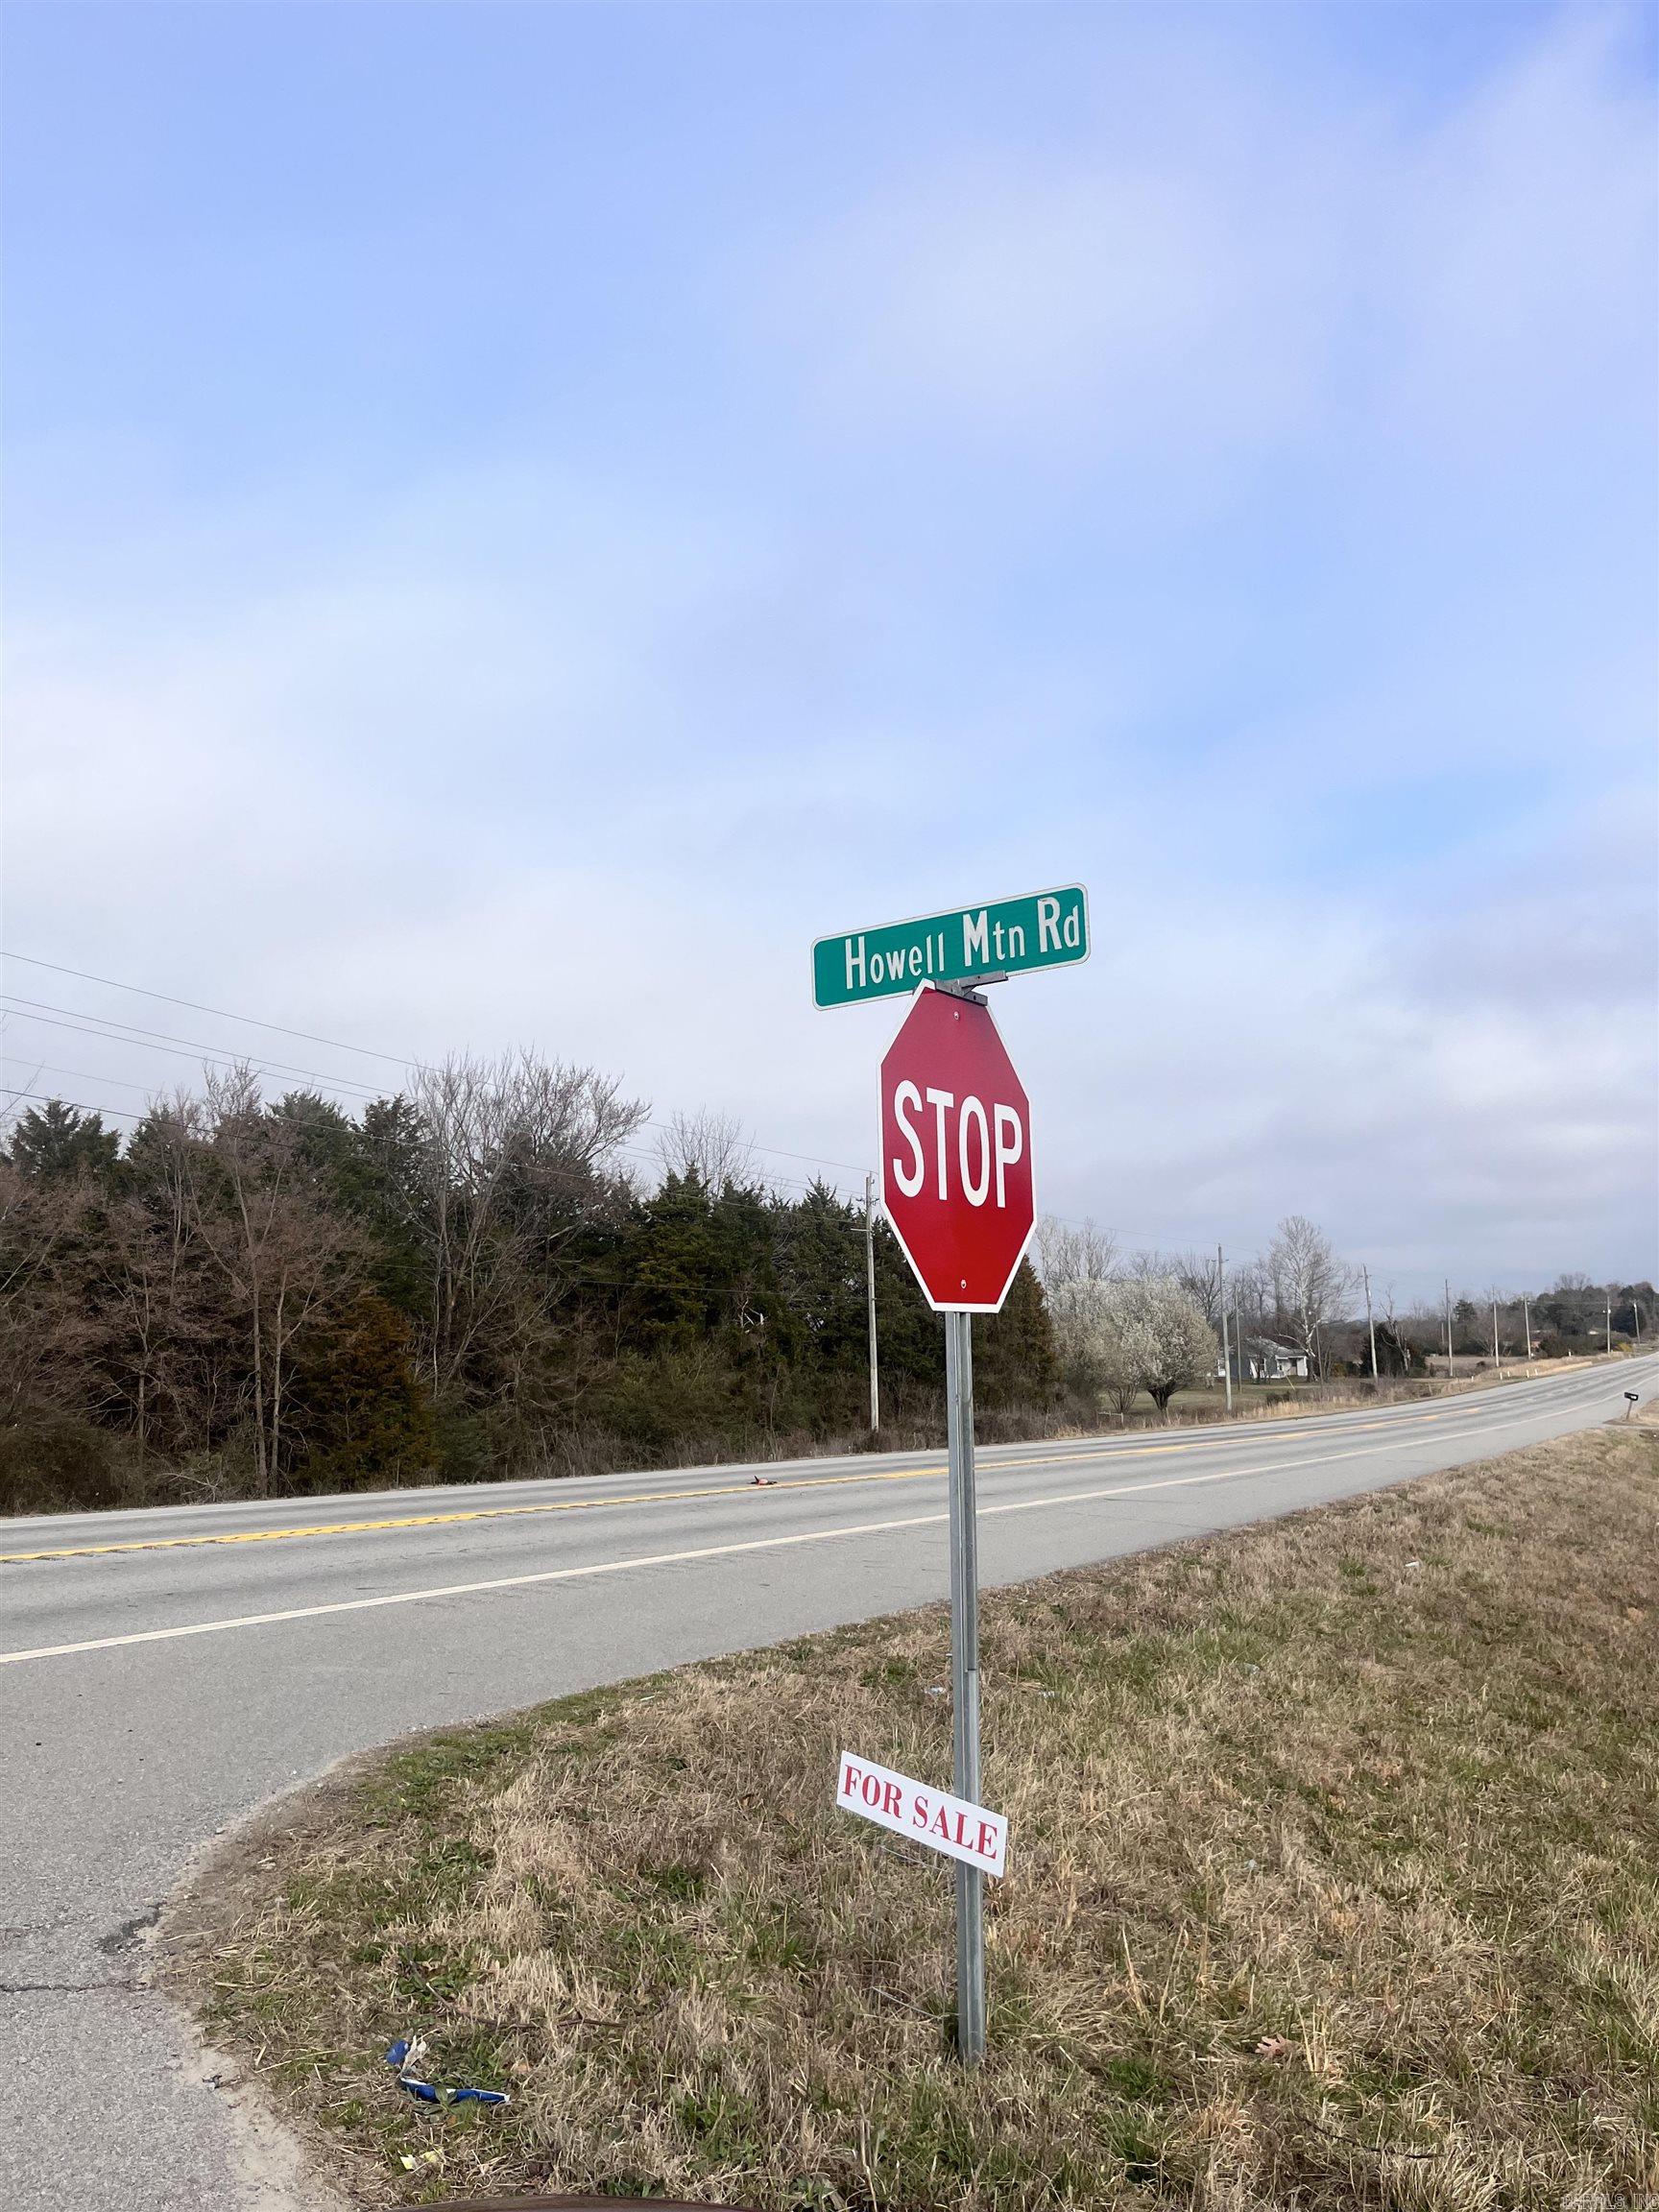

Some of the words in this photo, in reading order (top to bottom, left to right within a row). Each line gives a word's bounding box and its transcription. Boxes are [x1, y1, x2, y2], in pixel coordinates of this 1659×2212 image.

[845, 932, 945, 990] Howell
[963, 910, 1025, 967] Mtn
[1037, 896, 1080, 953] Rd
[893, 1079, 1023, 1209] STOP
[842, 1764, 902, 1819] FOR
[912, 1795, 998, 1860] SALE
